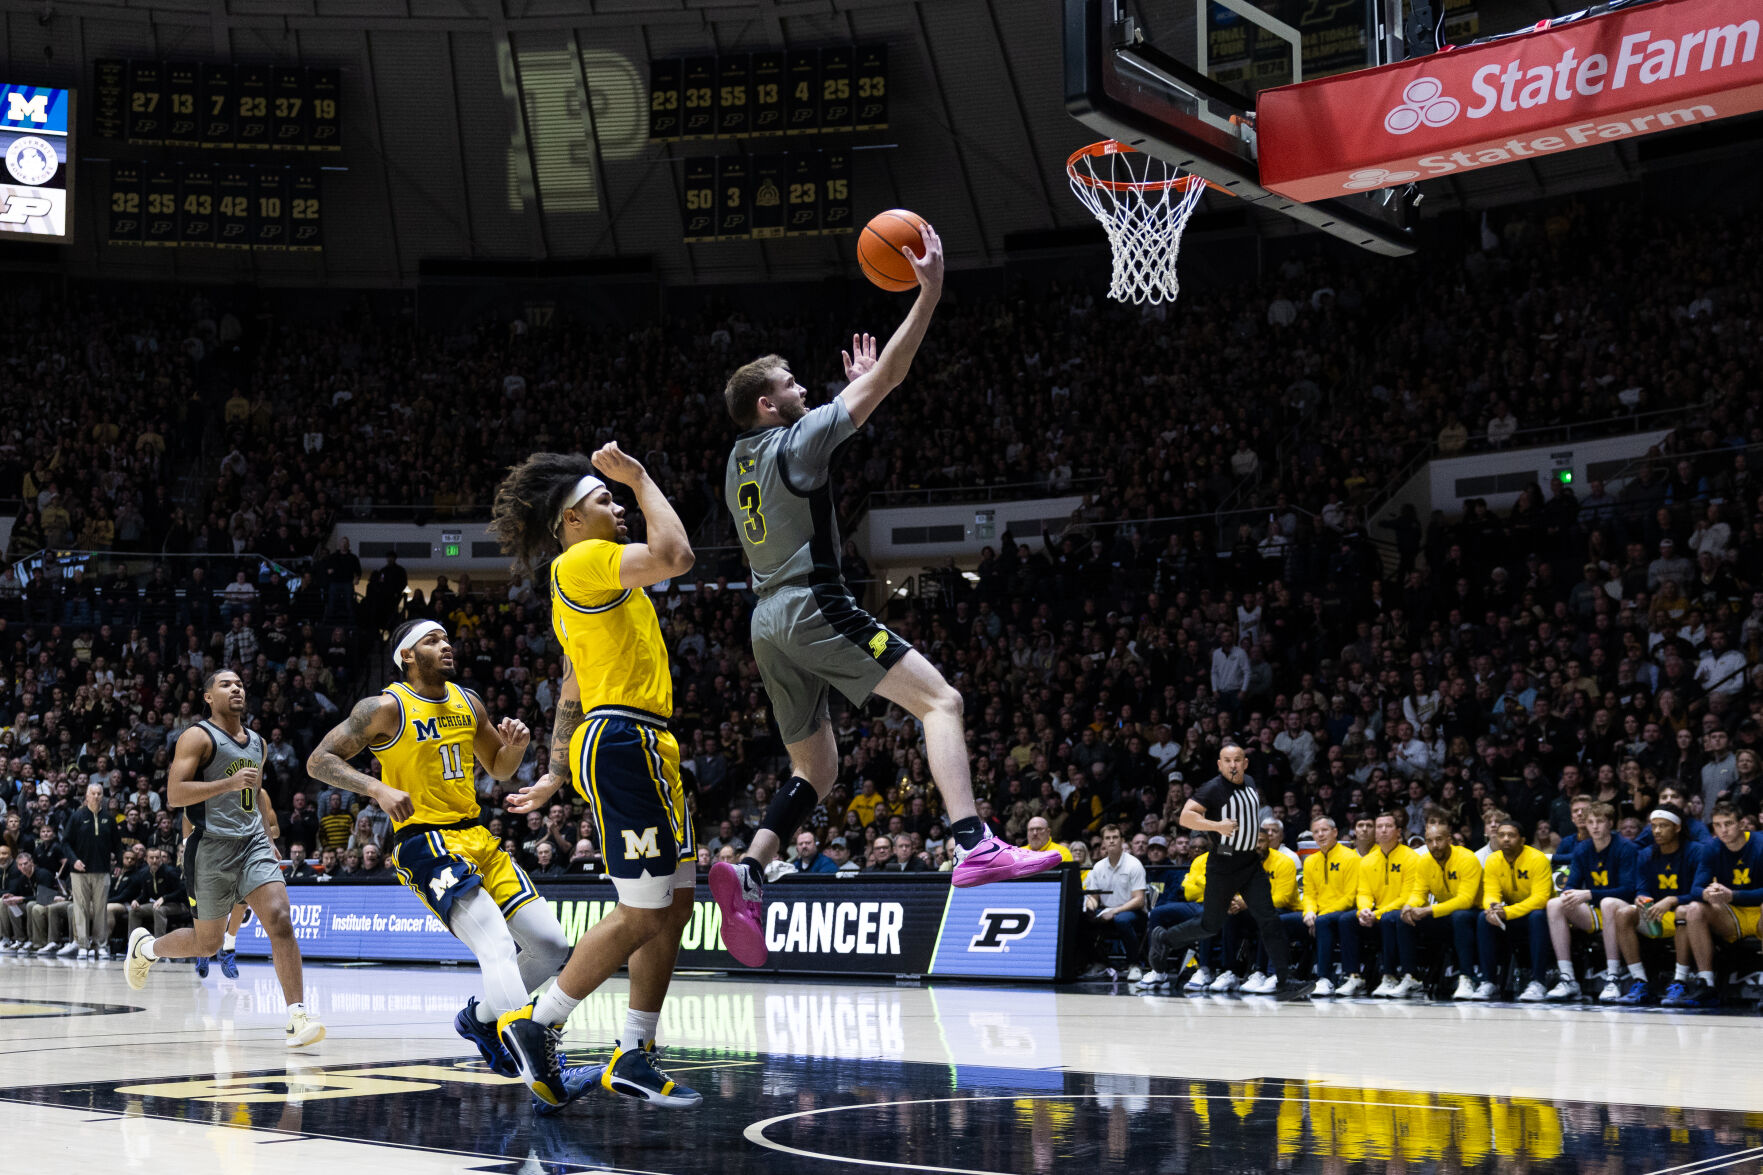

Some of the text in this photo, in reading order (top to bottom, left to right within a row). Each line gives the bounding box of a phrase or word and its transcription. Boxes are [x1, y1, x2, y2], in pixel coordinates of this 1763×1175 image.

[1210, 25, 1248, 45] FINAL
[1447, 21, 1471, 37] 024
[685, 87, 712, 108] 33
[720, 85, 747, 106] 55
[757, 83, 778, 104] 13
[794, 81, 809, 102] 4
[823, 78, 850, 100] 25
[858, 76, 886, 98] 33
[8, 92, 48, 123] M
[131, 92, 160, 112] 27
[171, 93, 194, 114] 13
[211, 95, 225, 116] 7
[240, 96, 267, 117] 23
[275, 97, 302, 118] 37
[313, 98, 336, 119] 19
[652, 90, 678, 111] 23
[686, 188, 713, 210] 50
[727, 187, 740, 208] 3
[789, 182, 816, 204] 23
[826, 178, 848, 200] 15
[112, 192, 140, 213] 32
[148, 193, 176, 215] 35
[183, 194, 212, 215] 43
[219, 196, 248, 217] 42
[259, 197, 281, 218] 10
[292, 198, 320, 219] 22
[737, 480, 767, 545] 3
[868, 630, 889, 659] P
[412, 715, 473, 742] MICHIGAN
[439, 743, 465, 780] 11
[241, 787, 254, 813] 0
[621, 826, 661, 860] M
[1330, 862, 1340, 872] M
[1391, 863, 1401, 873] M
[1447, 870, 1458, 880] M
[1517, 869, 1529, 880] M
[1732, 867, 1752, 886] M
[429, 866, 459, 901] M
[1590, 869, 1609, 887] M
[1657, 873, 1679, 890] M
[332, 913, 371, 931] Institute
[372, 913, 388, 931] for
[388, 914, 425, 932] Cancer
[765, 901, 904, 955] CANCER
[968, 907, 1036, 953] P
